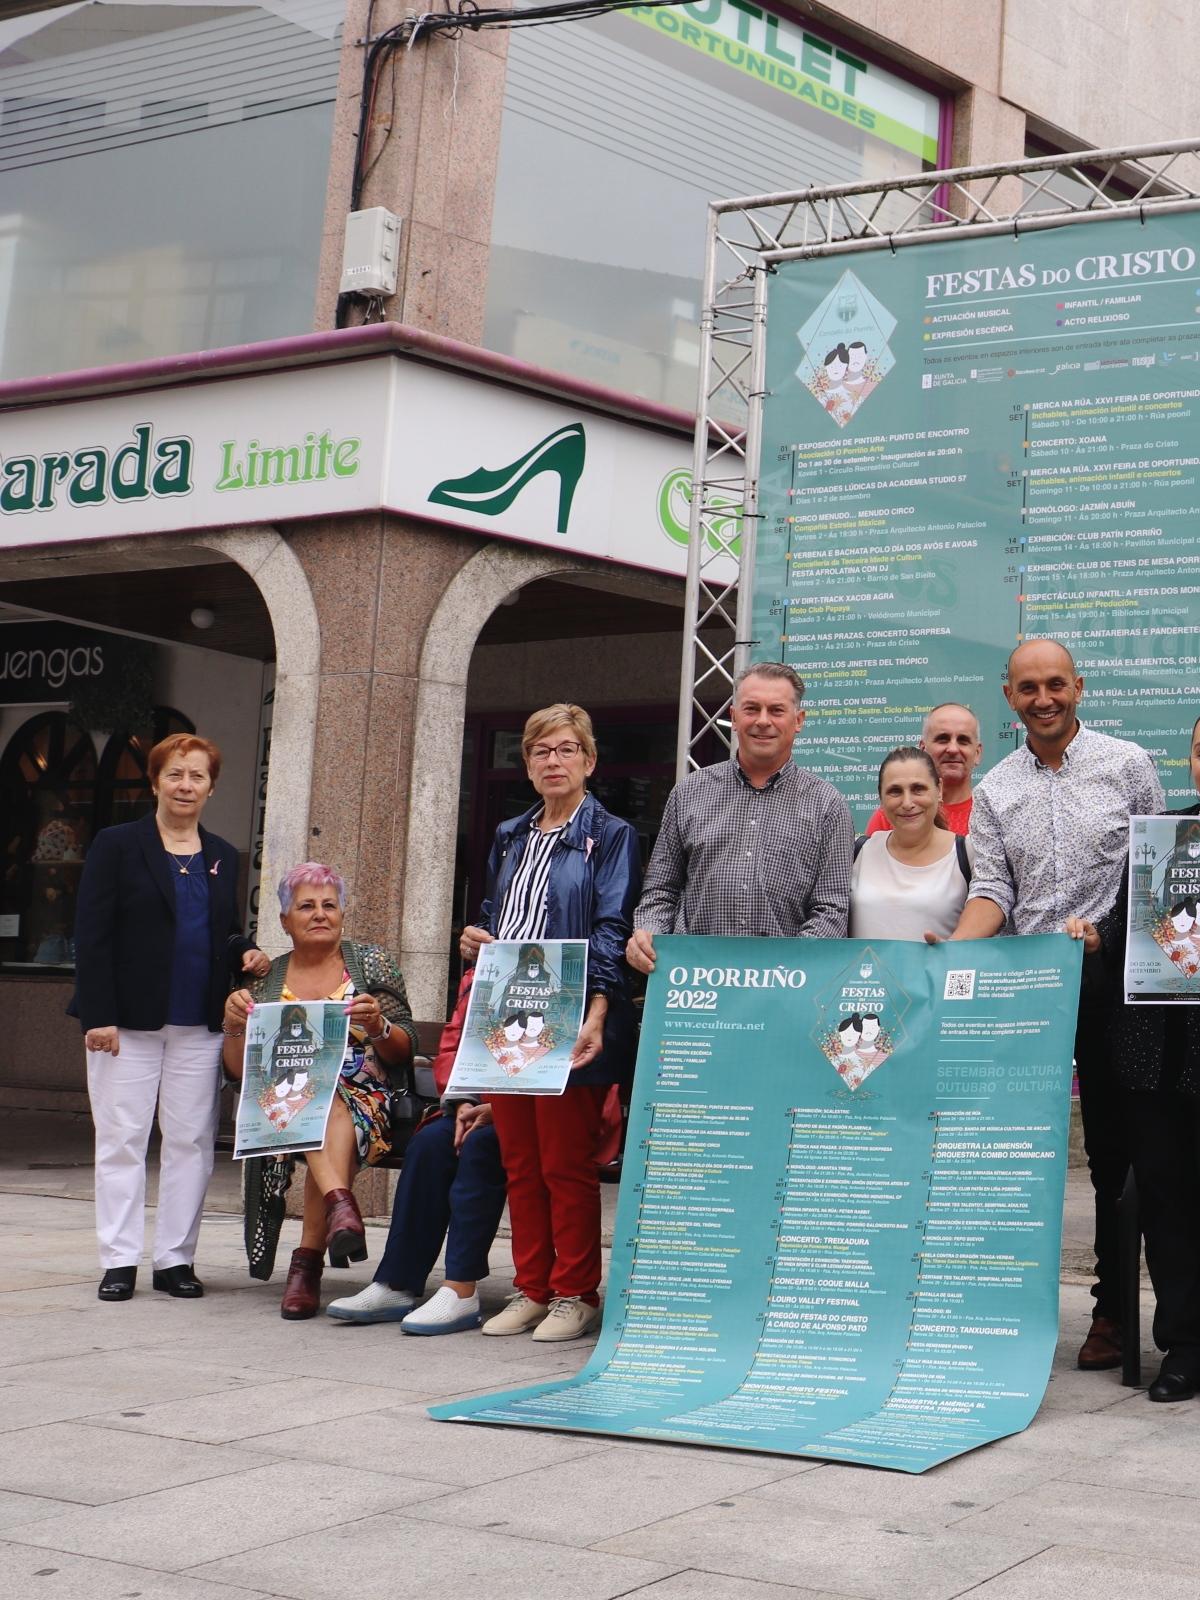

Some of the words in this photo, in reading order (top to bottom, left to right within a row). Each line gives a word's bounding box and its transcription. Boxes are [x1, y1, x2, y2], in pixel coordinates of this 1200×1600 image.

[926, 264, 1036, 298] FESTAS
[1042, 269, 1070, 286] DO
[1075, 247, 1195, 282] CRISTO
[1064, 299, 1098, 309] INFANTIL
[1104, 295, 1141, 306] FAMILIAR
[932, 310, 975, 323] ACTUACIÓN
[977, 308, 1011, 319] MUSICAL
[1064, 317, 1085, 326] ACTO
[1087, 313, 1129, 324] RELIXIOSO
[931, 328, 973, 340] EXPRESIÓN
[975, 324, 1013, 336] ESCÉNICA
[1033, 401, 1059, 409] MERCA
[1074, 397, 1092, 406] RÚA.
[1095, 397, 1112, 405] XXVI
[1114, 395, 1137, 403] FEIRA
[799, 439, 841, 450] EXPOSICIÓN
[853, 436, 887, 445] PINTURA:
[889, 433, 913, 442] PUNTO
[927, 428, 969, 438] ENCONTRO
[1031, 438, 1076, 447] CONCERTO:
[1078, 436, 1106, 444] XOANA
[0, 422, 194, 515] arada
[215, 430, 361, 492] Limite
[795, 514, 817, 522] CIRCO
[818, 512, 855, 520] MENUDO...
[857, 509, 889, 518] MENUDO
[891, 507, 914, 515] CIRCO
[793, 569, 813, 577] FESTA
[815, 567, 859, 576] AFROLATINA
[670, 966, 687, 985] O
[693, 964, 806, 988] PORRIÑO
[509, 986, 551, 996] FESTAS
[841, 987, 885, 998] FESTAS
[506, 1000, 549, 1009] CRISTO
[666, 990, 717, 1009] 2022
[839, 1001, 883, 1013] CRISTO
[664, 1020, 765, 1031] www.ecultura.net
[277, 1045, 315, 1054] FESTAS
[276, 1058, 313, 1067] CRISTO
[937, 1065, 1005, 1078] SETEMBRO
[1008, 1065, 1062, 1077] CULTURA
[936, 1081, 997, 1093] OUTUBRO
[1008, 1080, 1062, 1092] CULTURA
[781, 1236, 821, 1244] CONCERTO:
[823, 1237, 869, 1245] TREIXADURA
